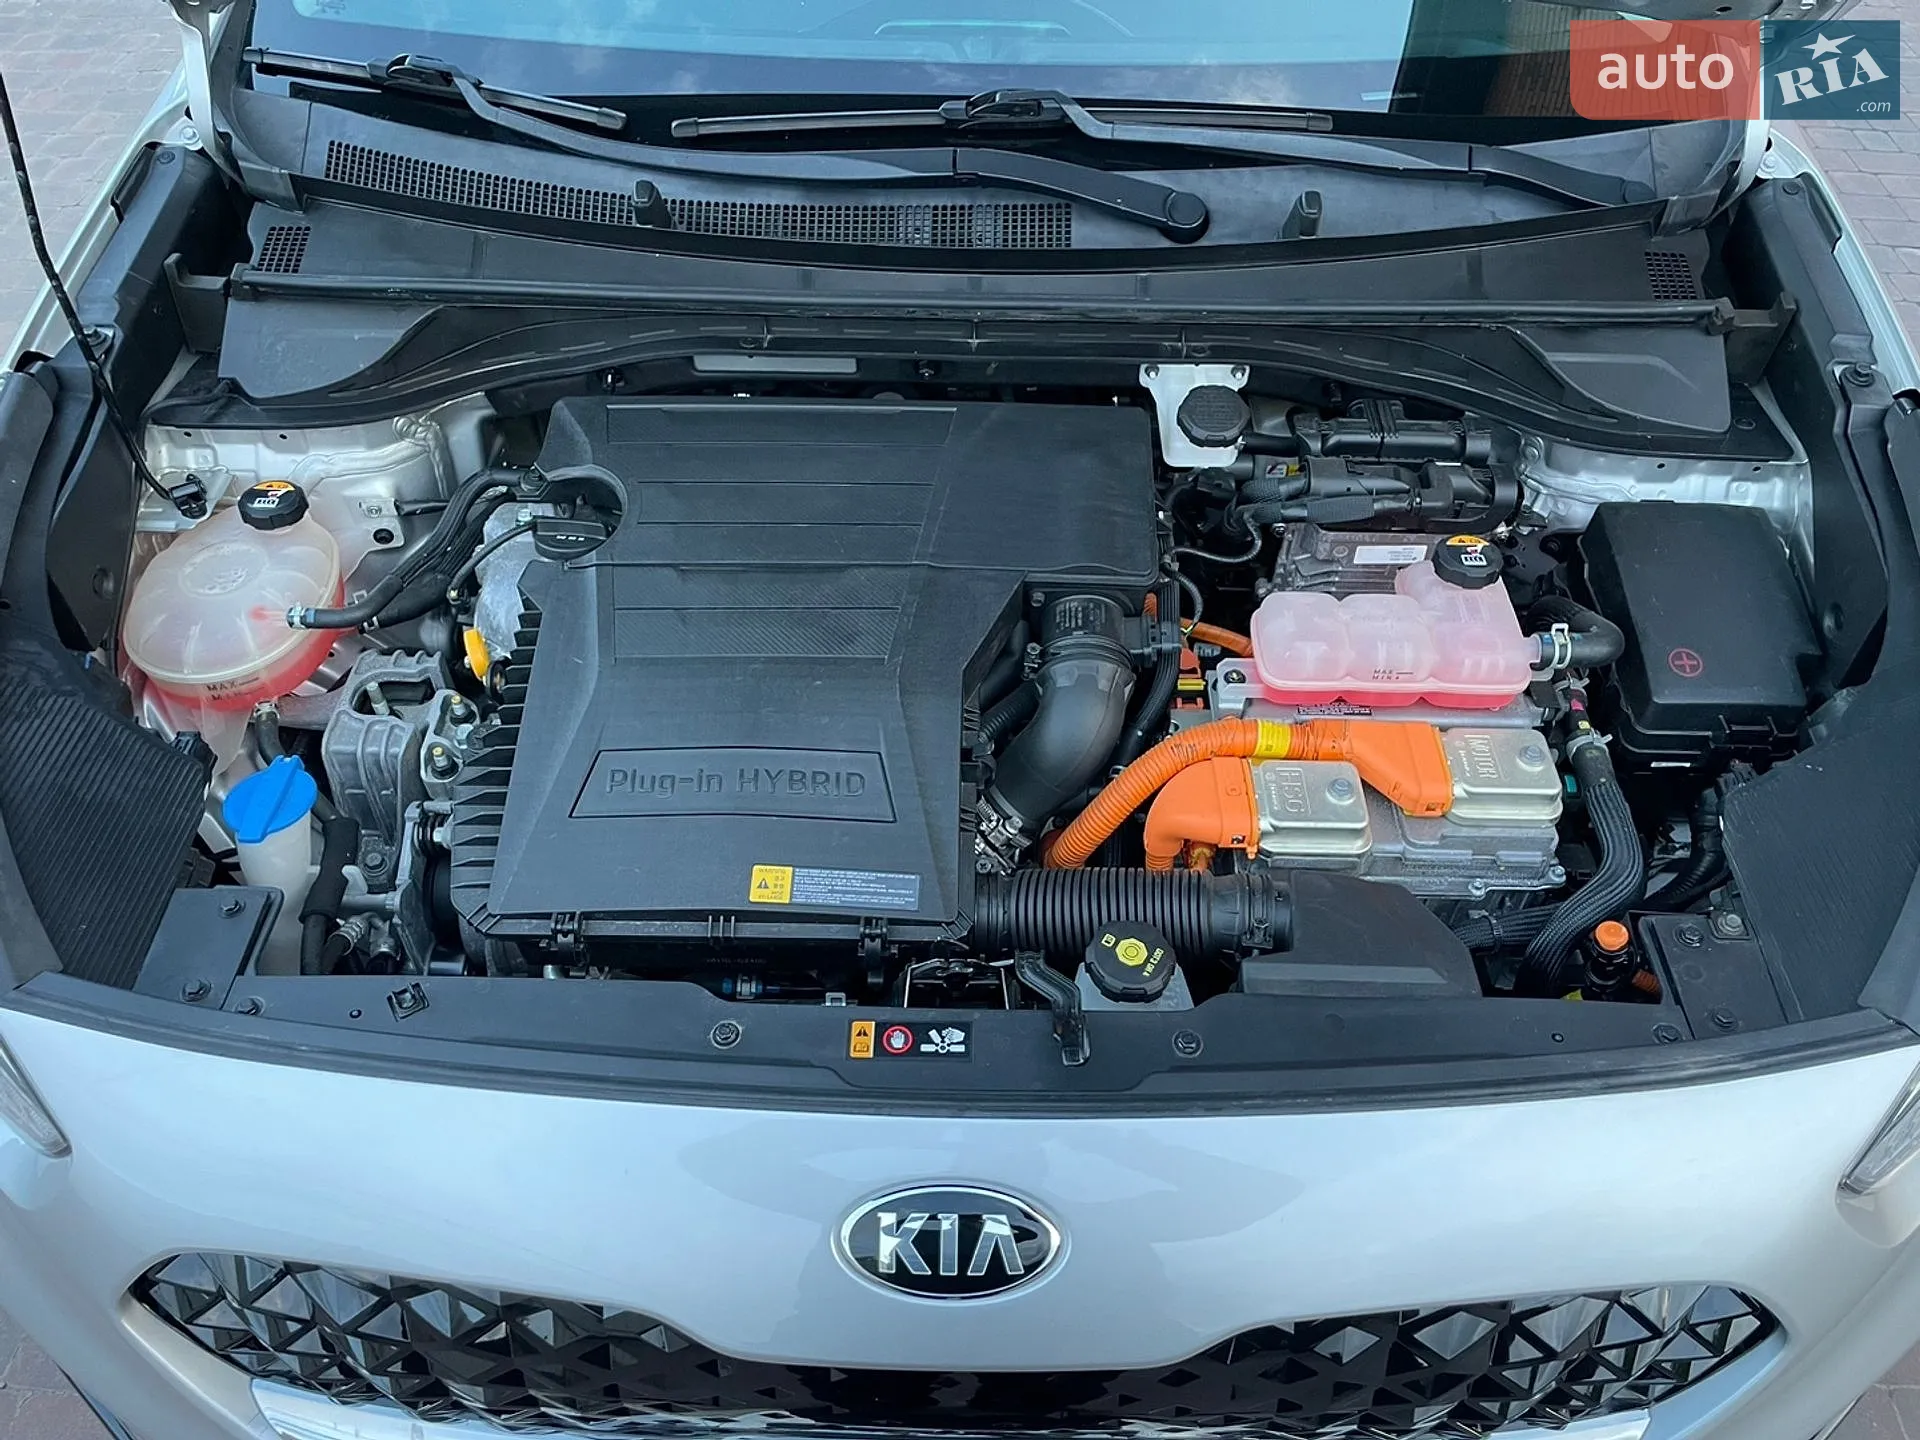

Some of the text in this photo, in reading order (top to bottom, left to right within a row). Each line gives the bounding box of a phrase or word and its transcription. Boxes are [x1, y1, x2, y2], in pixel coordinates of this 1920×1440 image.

[206, 681, 237, 691] MAX
[606, 768, 866, 799] Plug-in HYBRID
[877, 1212, 1024, 1276] KIA
